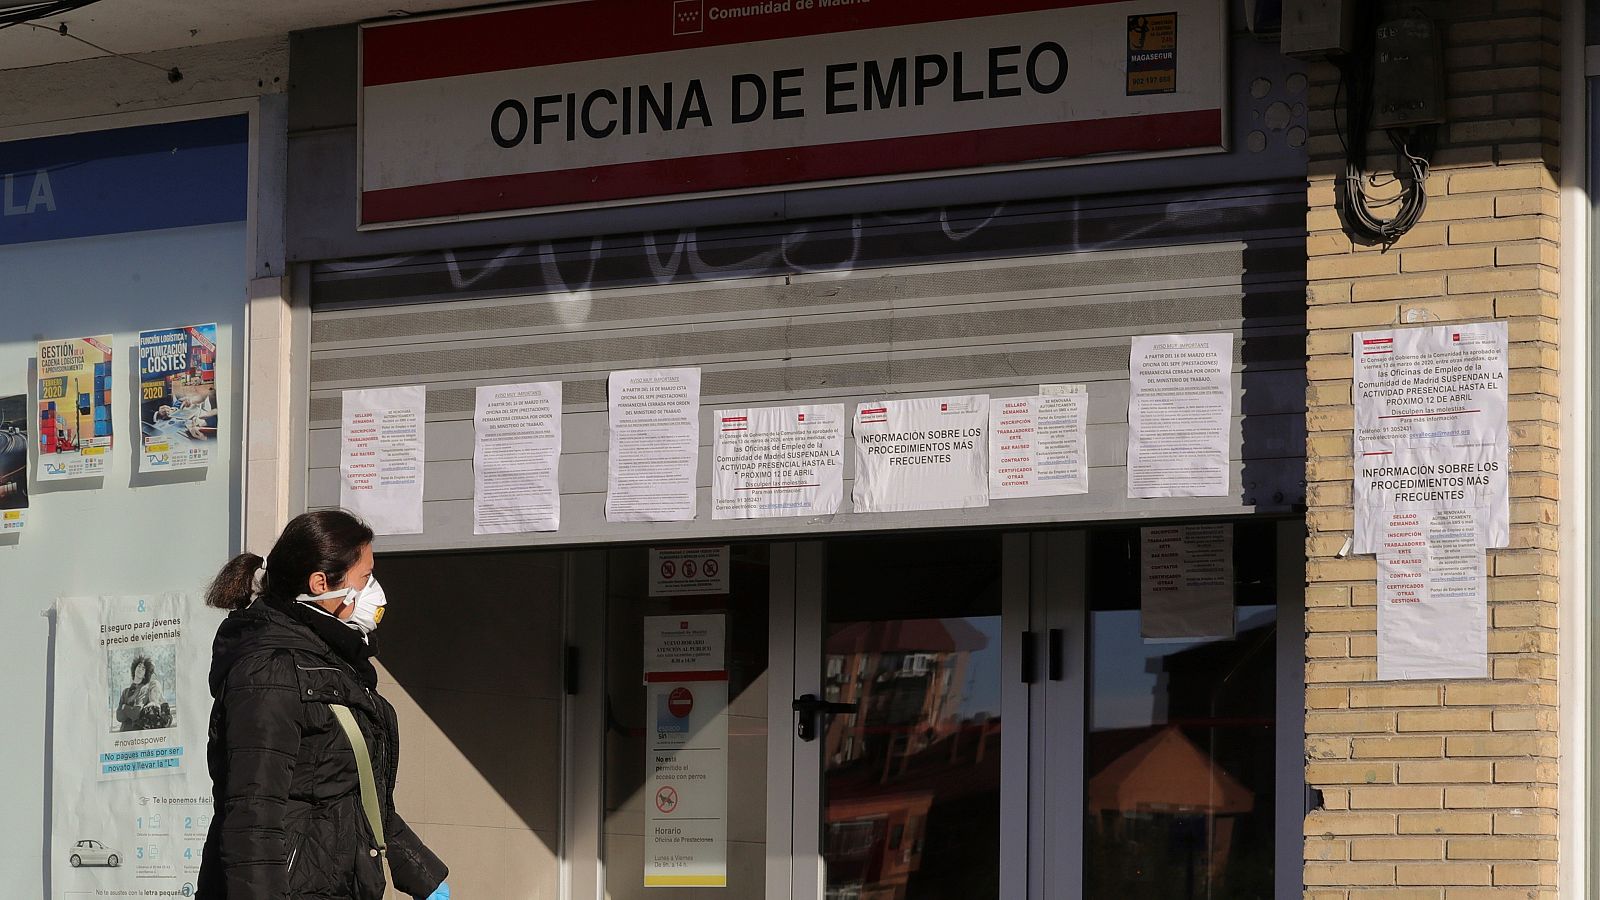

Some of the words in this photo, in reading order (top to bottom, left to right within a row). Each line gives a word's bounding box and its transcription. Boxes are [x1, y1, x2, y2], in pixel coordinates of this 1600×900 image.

[709, 0, 790, 20] Comunidad
[796, 0, 814, 10] de
[1132, 52, 1172, 61] MAGASEGUR
[490, 79, 713, 149] OFICINA
[731, 68, 806, 124] DE
[825, 41, 1069, 114] EMPLEO
[4, 170, 56, 216] LA
[141, 335, 160, 345] FUNCIÓN
[161, 333, 184, 343] LOGÍSTICA
[42, 342, 74, 358] GESTIÓN
[141, 340, 187, 358] OPTIMIZACIÓN
[42, 359, 60, 367] CADENA
[61, 356, 84, 365] LOGÍSTICA
[148, 354, 186, 373] COSTES
[1391, 369, 1421, 377] Oficinas
[1435, 365, 1463, 375] Empleo
[1358, 379, 1399, 388] Comunidad
[1402, 378, 1411, 386] de
[1442, 374, 1490, 383] SUSPENDAN
[1492, 372, 1503, 380] LA
[44, 386, 61, 398] 2020
[144, 387, 162, 399] 2020
[1363, 388, 1404, 398] ACTIVIDAD
[1407, 386, 1456, 395] PRESENCIAL
[1426, 396, 1434, 404] 12
[1450, 394, 1472, 402] ABRIL
[861, 431, 925, 443] INFORMACIÓN
[928, 430, 960, 439] SOBRE
[963, 428, 981, 438] LOS
[868, 442, 950, 454] PROCEDIMIENTOS
[890, 455, 951, 465] FRECUENTES
[1362, 464, 1434, 477] INFORMACIÓN
[1438, 463, 1474, 473] SOBRE
[1478, 462, 1498, 471] LOS
[1371, 477, 1463, 490] PROCEDIMIENTOS
[1466, 474, 1489, 485] MÁS
[1395, 491, 1464, 502] FRECUENTES
[101, 625, 106, 633] El
[108, 624, 132, 633] seguro
[134, 621, 150, 631] para
[152, 618, 181, 629] jóvenes
[106, 635, 128, 646] precio
[131, 633, 139, 642] de
[141, 629, 181, 641] viejennials
[114, 736, 167, 748] #novatospower
[116, 752, 139, 761] pagues
[156, 749, 167, 757] por
[108, 764, 130, 772] novato
[157, 760, 164, 768] la
[199, 796, 213, 804] fácil
[136, 817, 142, 828] 1
[184, 817, 192, 829] 2
[136, 848, 143, 859] 3
[184, 848, 192, 859] 4
